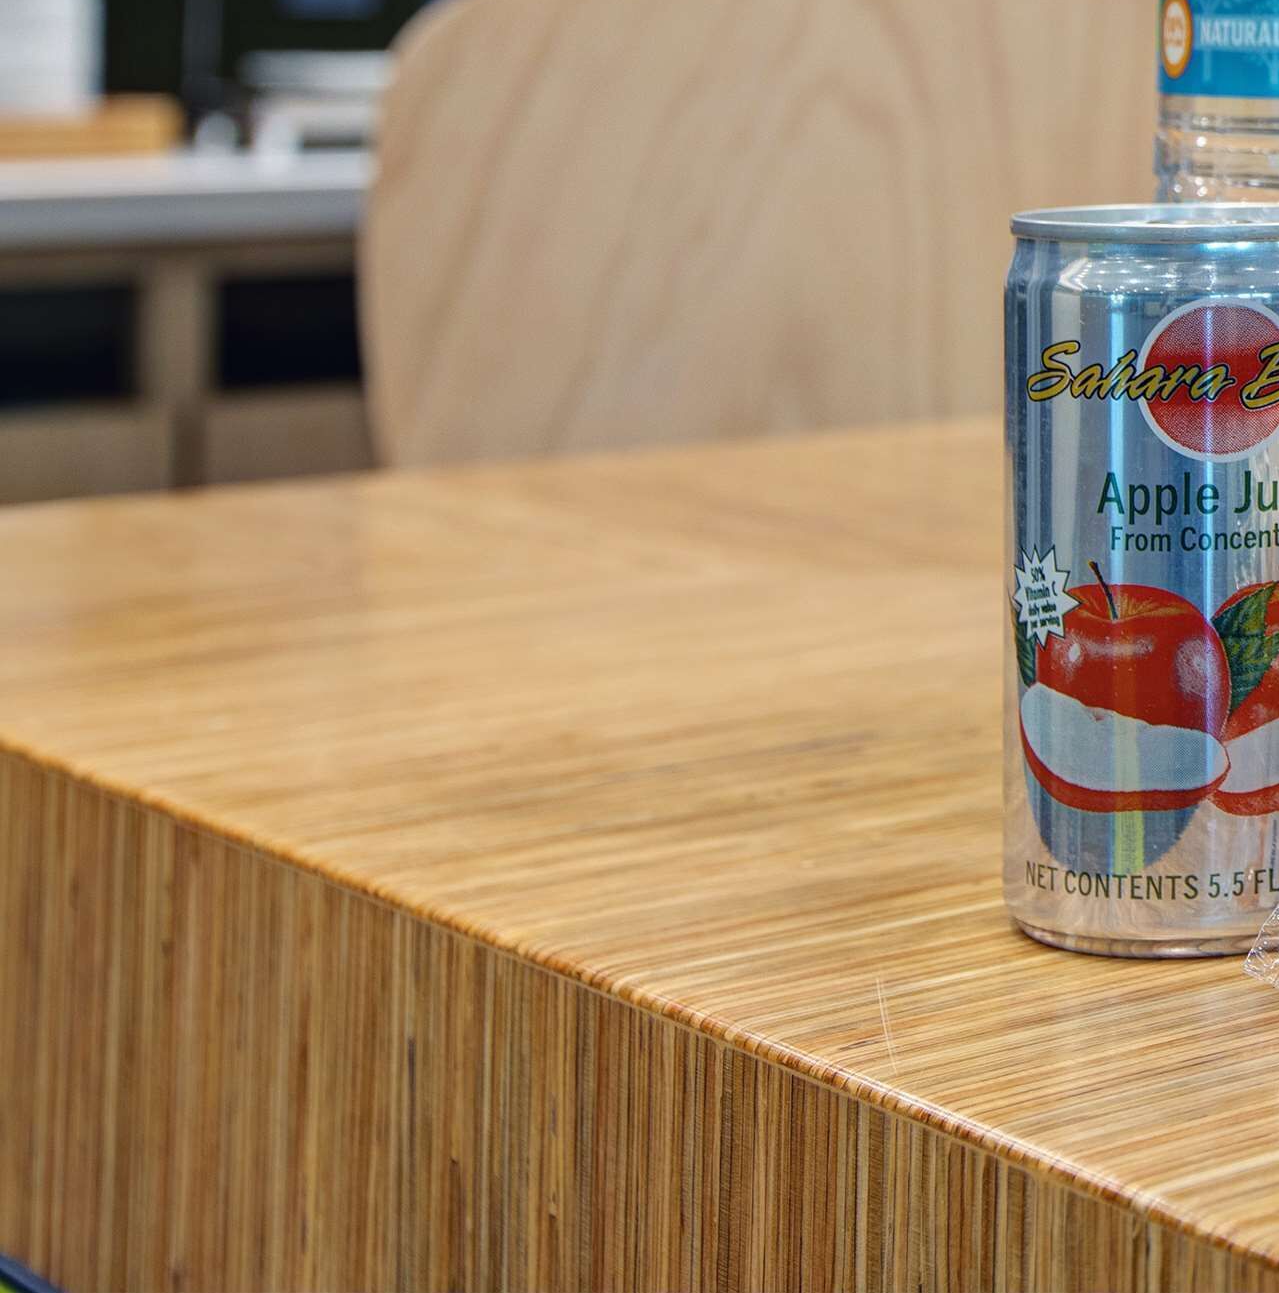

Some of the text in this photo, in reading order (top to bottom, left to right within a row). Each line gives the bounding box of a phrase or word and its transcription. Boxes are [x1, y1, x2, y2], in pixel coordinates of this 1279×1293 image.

[1026, 339, 1238, 402] Sahara
[1096, 471, 1221, 527] Apple
[1111, 526, 1172, 553] From
[1025, 860, 1056, 892] NET
[1064, 871, 1200, 901] CONTENTS
[1207, 870, 1245, 898] 5.5
